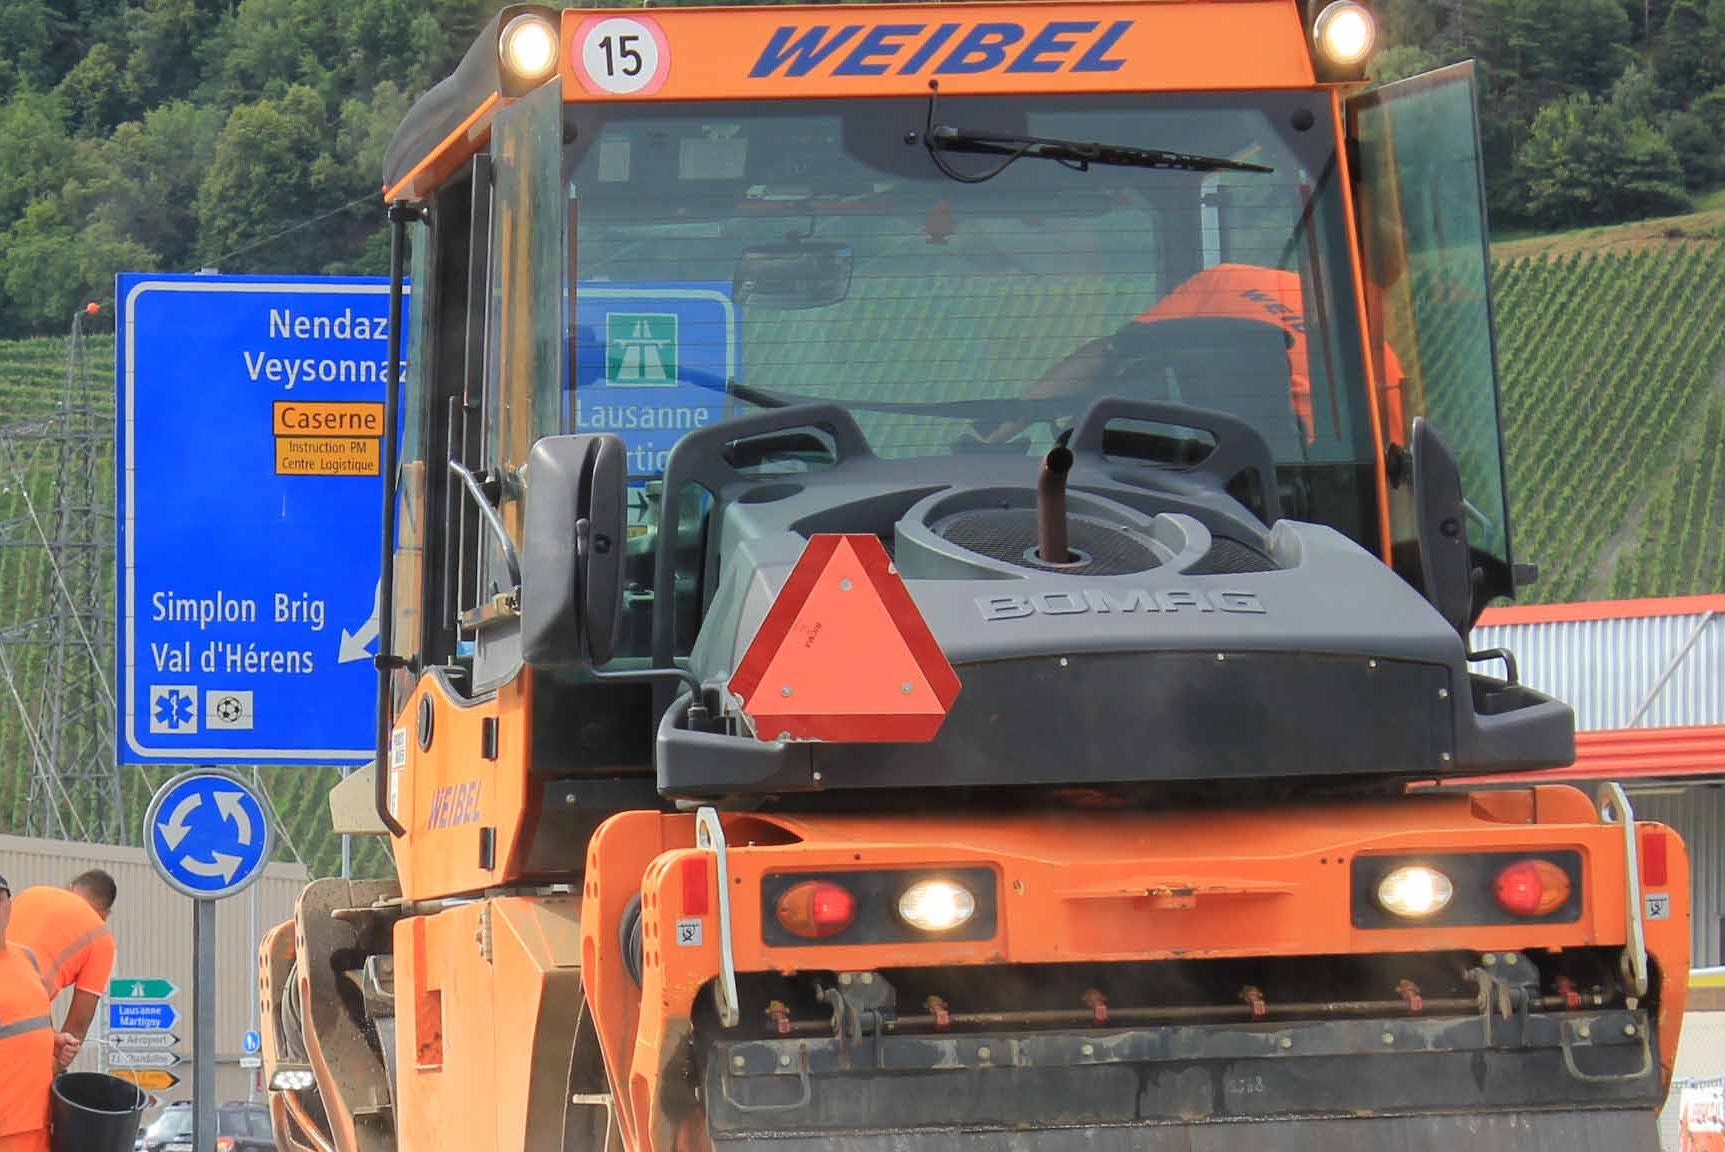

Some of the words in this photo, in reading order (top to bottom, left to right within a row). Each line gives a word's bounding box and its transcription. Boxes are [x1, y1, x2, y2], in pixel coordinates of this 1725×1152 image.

[598, 35, 643, 77] 15
[748, 19, 1134, 79] WEIBEL
[269, 308, 388, 340] Nendaz
[281, 407, 377, 430] Caserne
[576, 398, 709, 429] Lausanne
[289, 441, 346, 454] Instruction
[350, 441, 367, 454] PM
[282, 457, 316, 471] Centre
[320, 458, 375, 474] Logistique
[152, 590, 257, 631] Simplon
[274, 592, 325, 632] Brig
[975, 588, 1267, 622] BOMAG
[150, 641, 191, 673] Val
[200, 641, 315, 674] d'Hérens
[428, 779, 482, 830] WEIBEL
[119, 1005, 162, 1016] Lausanne
[120, 1016, 162, 1028] Martigny
